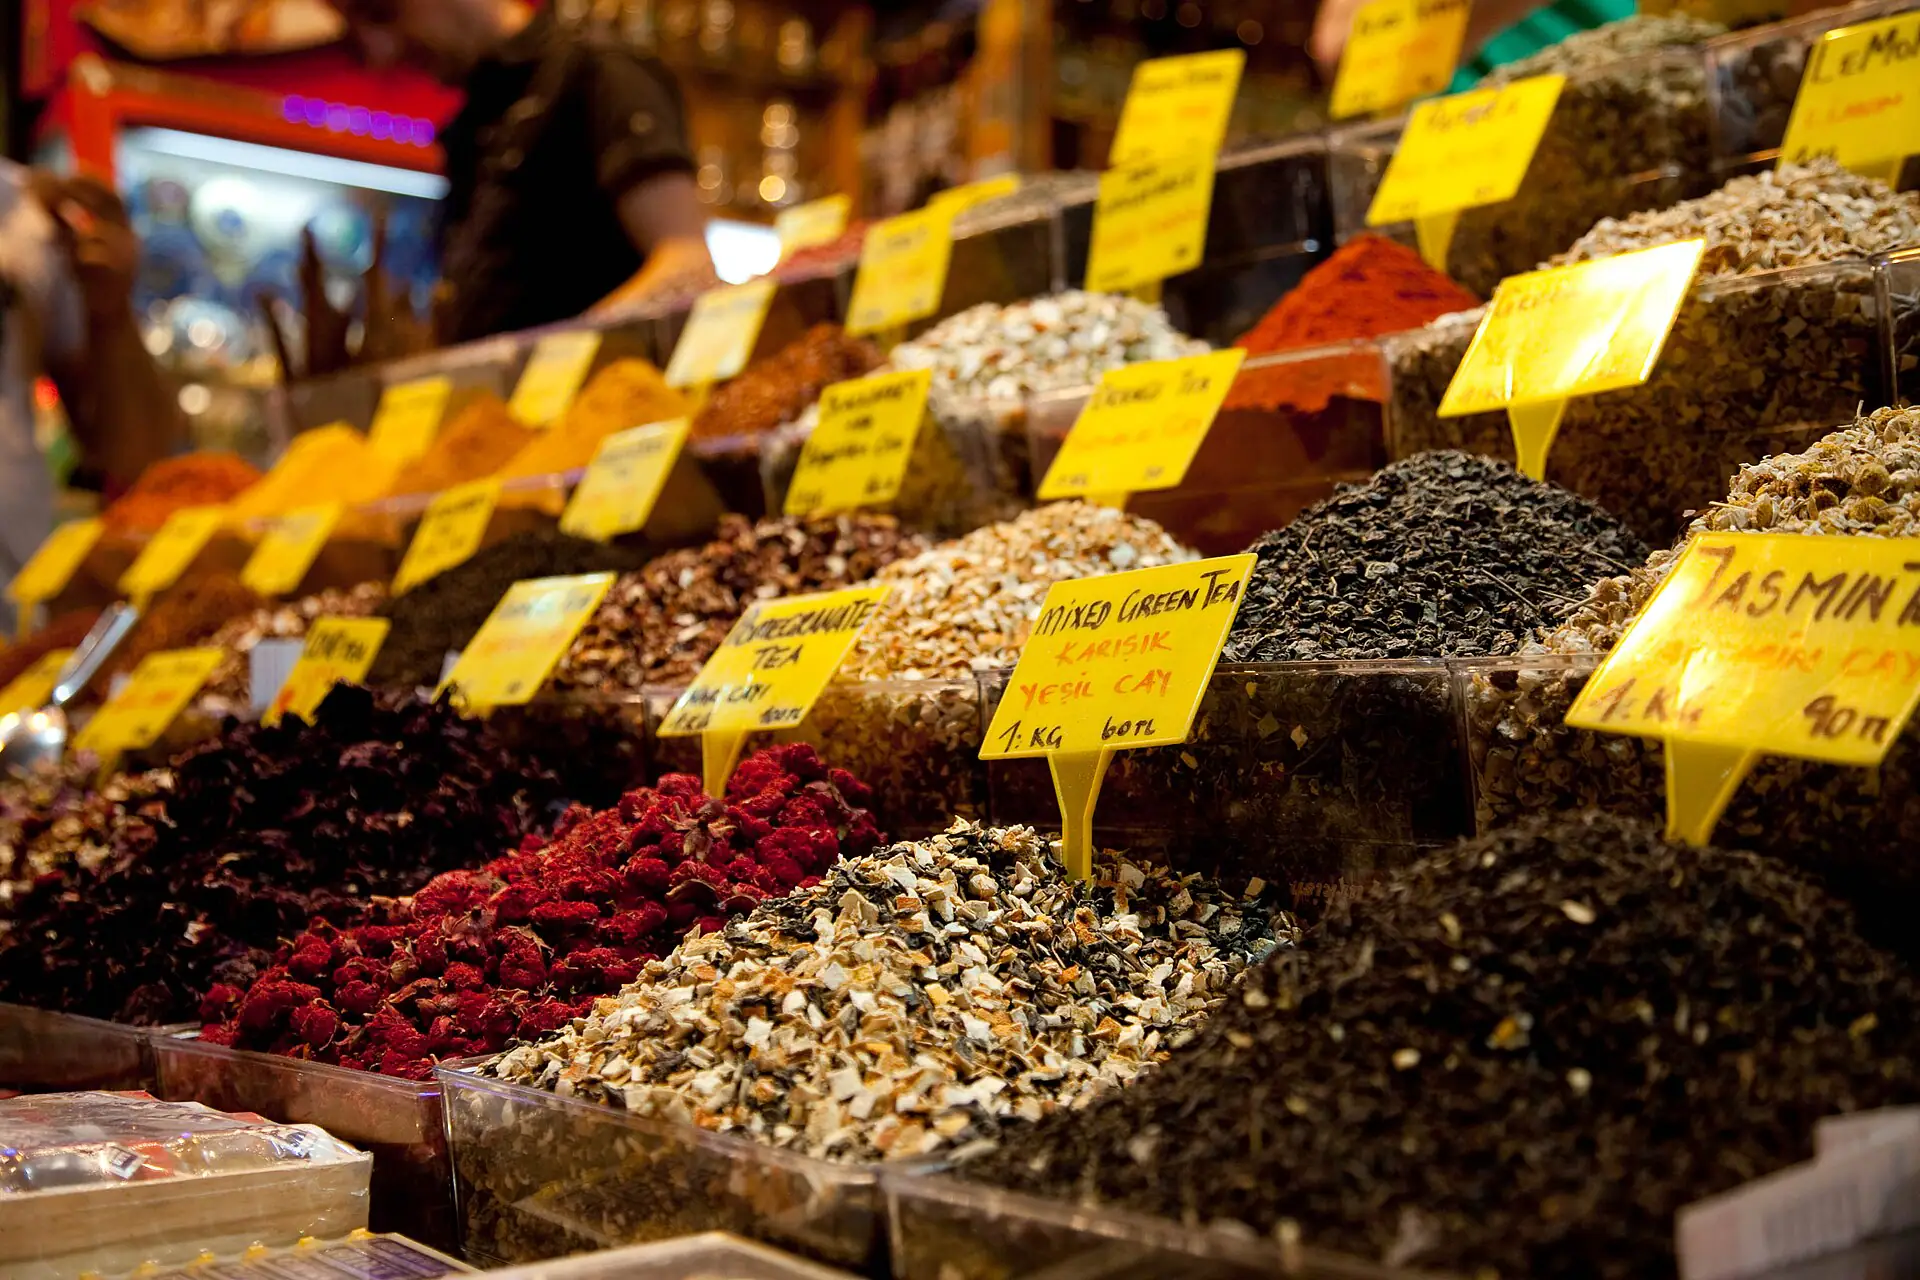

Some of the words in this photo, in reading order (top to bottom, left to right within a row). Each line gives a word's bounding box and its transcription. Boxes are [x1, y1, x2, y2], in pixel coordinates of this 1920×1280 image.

[1117, 588, 1200, 623] GREEN
[1200, 569, 1240, 611] TEA
[1692, 545, 1897, 624] JASMIN
[752, 644, 804, 670] TEA
[1030, 725, 1063, 749] KG
